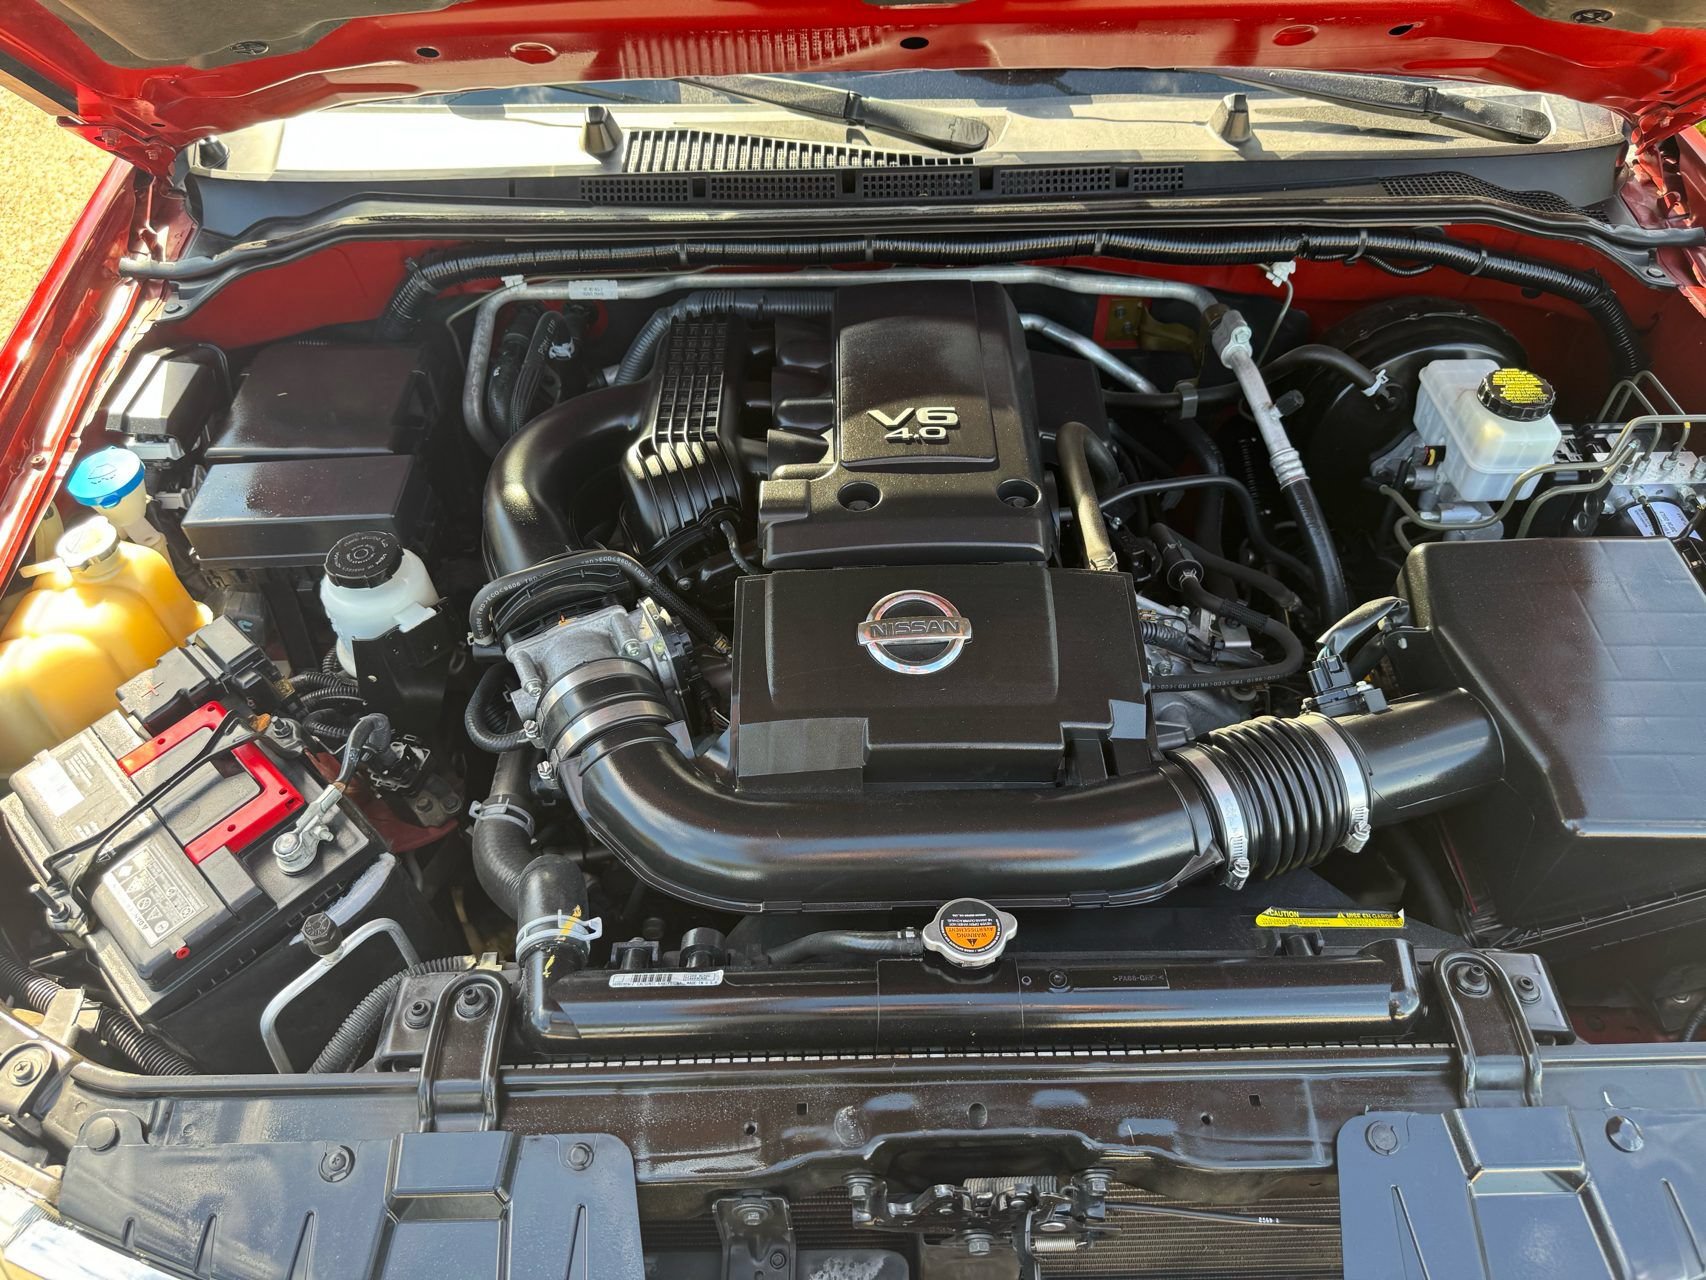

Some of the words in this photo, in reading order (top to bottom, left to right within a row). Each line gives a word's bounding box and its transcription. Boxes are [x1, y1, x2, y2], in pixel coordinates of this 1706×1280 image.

[866, 407, 958, 426] V6
[884, 427, 947, 441] 4.0
[871, 620, 960, 637] NISSAN
[1271, 910, 1299, 918] CAUTION
